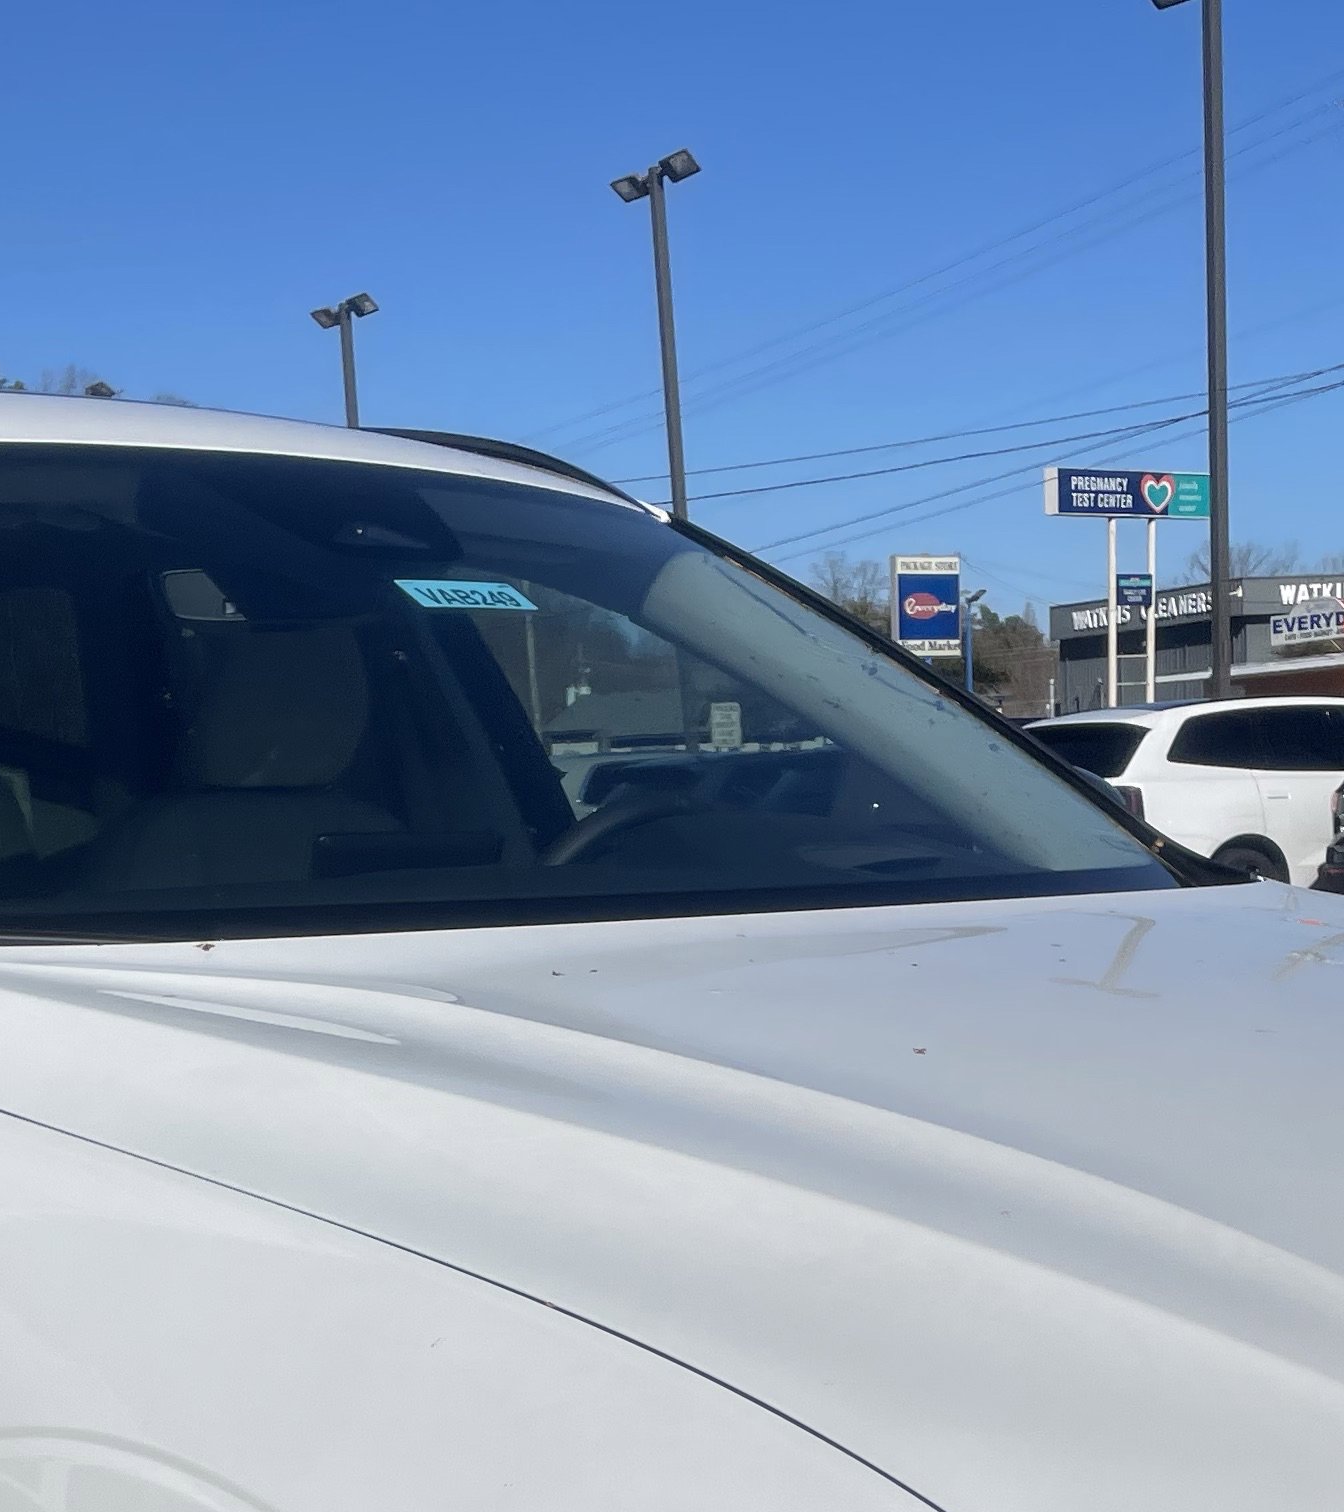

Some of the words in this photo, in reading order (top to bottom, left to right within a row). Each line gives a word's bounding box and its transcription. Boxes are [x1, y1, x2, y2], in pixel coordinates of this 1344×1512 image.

[1070, 475, 1129, 492] PREGNANCY
[1071, 492, 1094, 508] TEST
[1097, 493, 1133, 509] CENTER
[414, 586, 522, 608] VAB249
